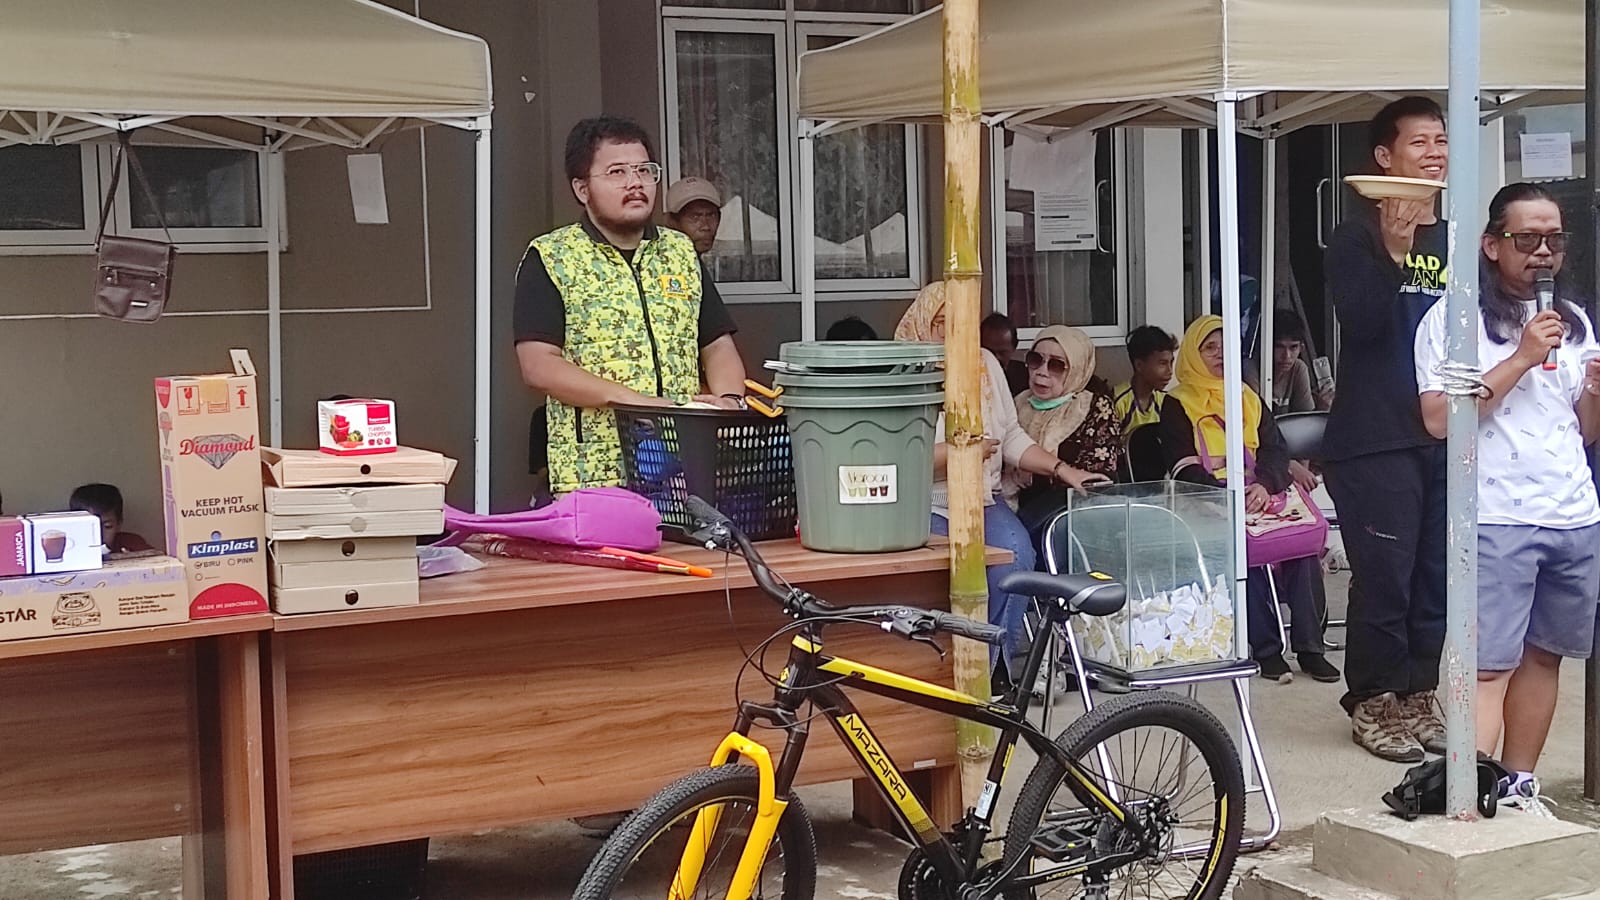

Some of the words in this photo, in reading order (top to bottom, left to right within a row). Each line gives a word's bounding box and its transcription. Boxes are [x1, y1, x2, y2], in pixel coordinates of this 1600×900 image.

[179, 434, 255, 455] Diamond
[195, 498, 221, 507] KEEP
[223, 496, 244, 505] HOT
[181, 507, 226, 518] VACUUM
[228, 503, 260, 514] FLASK
[15, 531, 25, 567] JAMAICA
[191, 540, 256, 555] Kimplast
[236, 557, 254, 565] PINK
[845, 715, 907, 800] MAZARA
